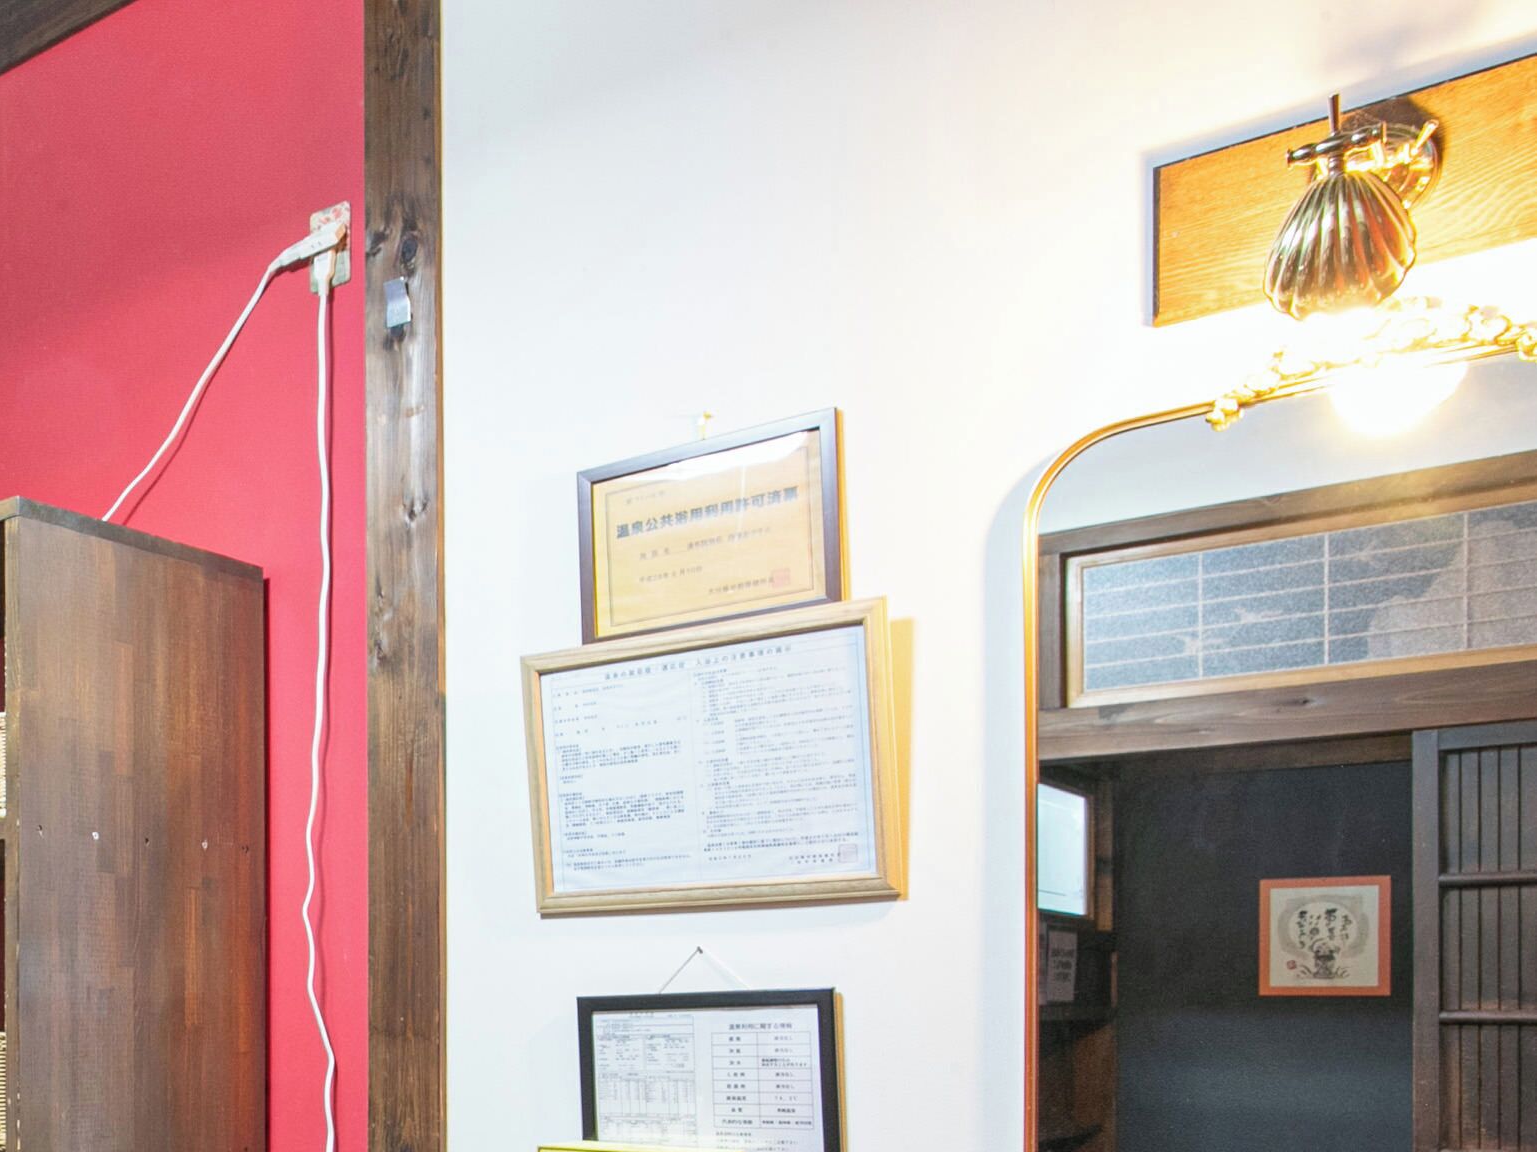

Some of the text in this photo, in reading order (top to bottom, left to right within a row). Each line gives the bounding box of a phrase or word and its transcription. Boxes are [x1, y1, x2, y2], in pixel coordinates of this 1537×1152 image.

[616, 485, 799, 539] 温泉公共浴用利用許可済票
